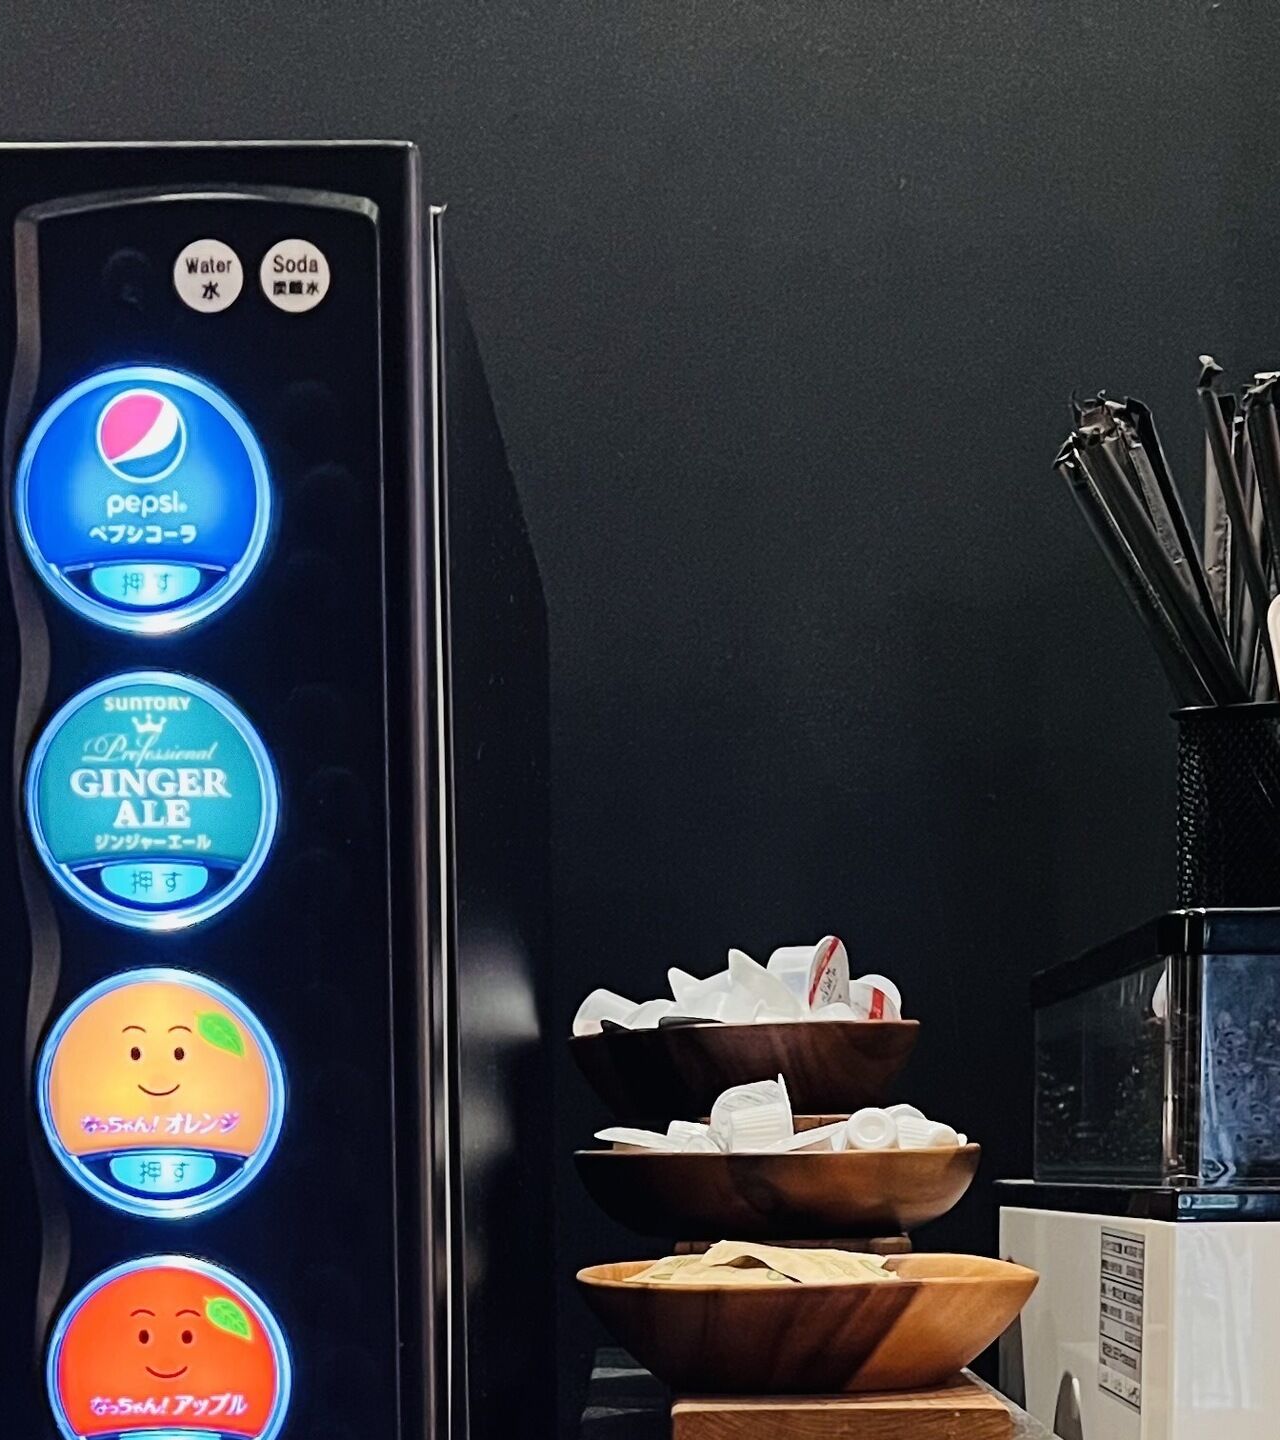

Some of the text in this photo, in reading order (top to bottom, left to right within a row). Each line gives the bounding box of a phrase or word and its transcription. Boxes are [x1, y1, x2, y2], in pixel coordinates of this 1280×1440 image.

[185, 254, 233, 274] Water
[273, 254, 319, 274] Soda
[201, 280, 221, 300] 水
[88, 524, 198, 544] ペプシコーラ
[103, 695, 192, 711] SUNTORY
[81, 731, 218, 768] Professional
[70, 767, 231, 798] GINGER
[112, 799, 192, 829] ALE
[95, 834, 211, 851] ジンジャーエール
[131, 871, 183, 893] 押す
[139, 1161, 191, 1185] 押す
[173, 1391, 248, 1416] アップル
